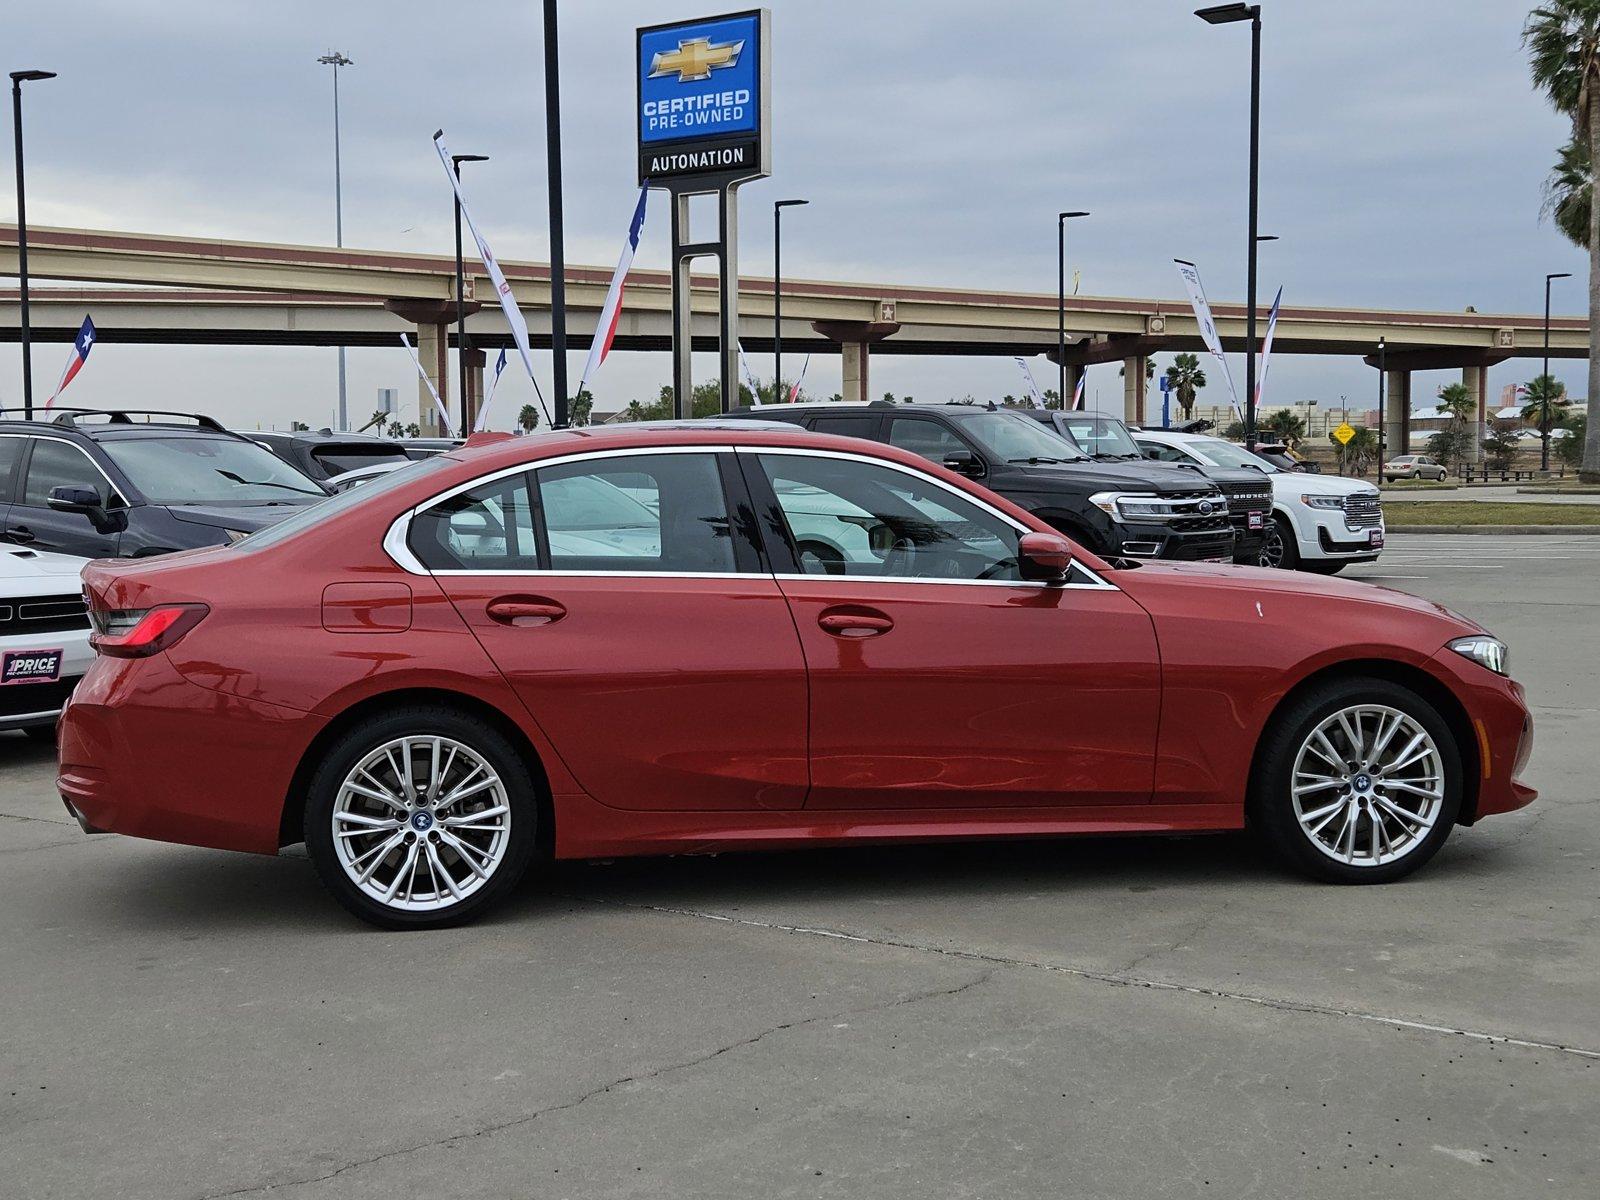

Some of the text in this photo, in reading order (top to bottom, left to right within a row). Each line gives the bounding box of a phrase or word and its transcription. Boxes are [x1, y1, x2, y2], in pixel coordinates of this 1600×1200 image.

[643, 89, 750, 116] CERTIFIED
[650, 106, 743, 130] PRE-OWNED
[651, 148, 744, 171] AUTONATION
